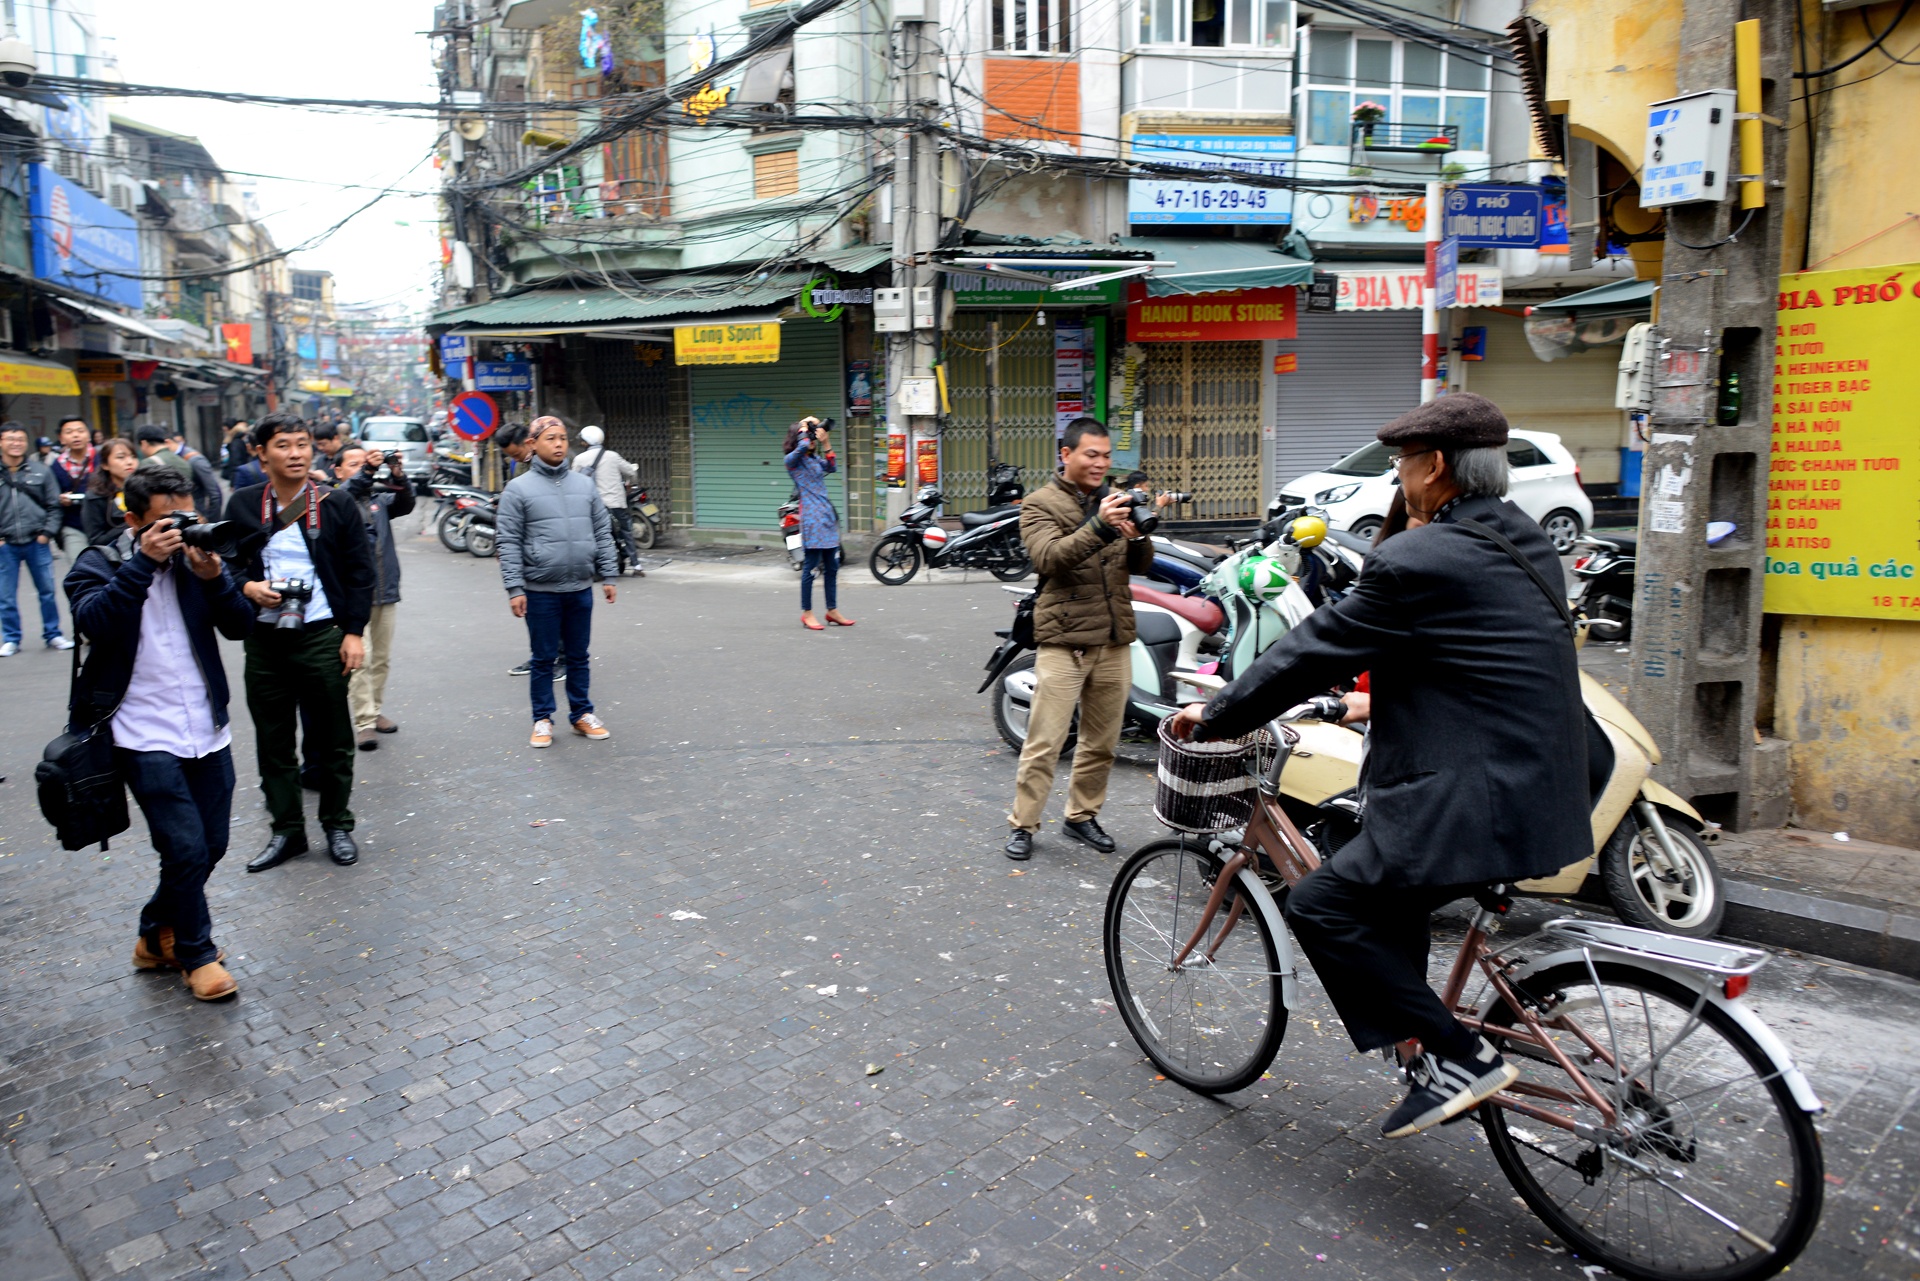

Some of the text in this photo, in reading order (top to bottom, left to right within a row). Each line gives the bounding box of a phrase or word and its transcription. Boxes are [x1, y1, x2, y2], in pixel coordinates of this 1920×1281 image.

[1156, 190, 1267, 208] 4-7-16-29-45
[1476, 193, 1511, 208] PHỐ
[944, 272, 982, 292] TOUR
[985, 270, 1048, 292] BOOKING
[1833, 272, 1904, 306] PHỐ
[1356, 276, 1391, 307] BIA
[1140, 303, 1284, 323] HANOI BOOK STORE
[693, 324, 762, 344] Long Sport
[1789, 322, 1816, 336] HƠI
[1789, 341, 1824, 356] TƯƠI
[1788, 359, 1869, 375] HEINEKEN
[1788, 381, 1832, 394] TIGER
[1838, 379, 1871, 395] BẠC
[1786, 418, 1806, 433] HÀ
[1812, 417, 1840, 435] NỘI
[1116, 420, 1132, 451] Book
[1786, 440, 1843, 453] HALIDA
[1802, 459, 1857, 472] CHANH
[1863, 457, 1900, 471] TƯƠI
[1812, 479, 1841, 491] LEO
[1787, 498, 1841, 511] CHANH
[1786, 516, 1818, 530] ĐÀO
[1785, 537, 1831, 549] ATISO
[1810, 556, 1859, 580] quả
[1869, 558, 1914, 578] các
[1872, 596, 1893, 607] 18
